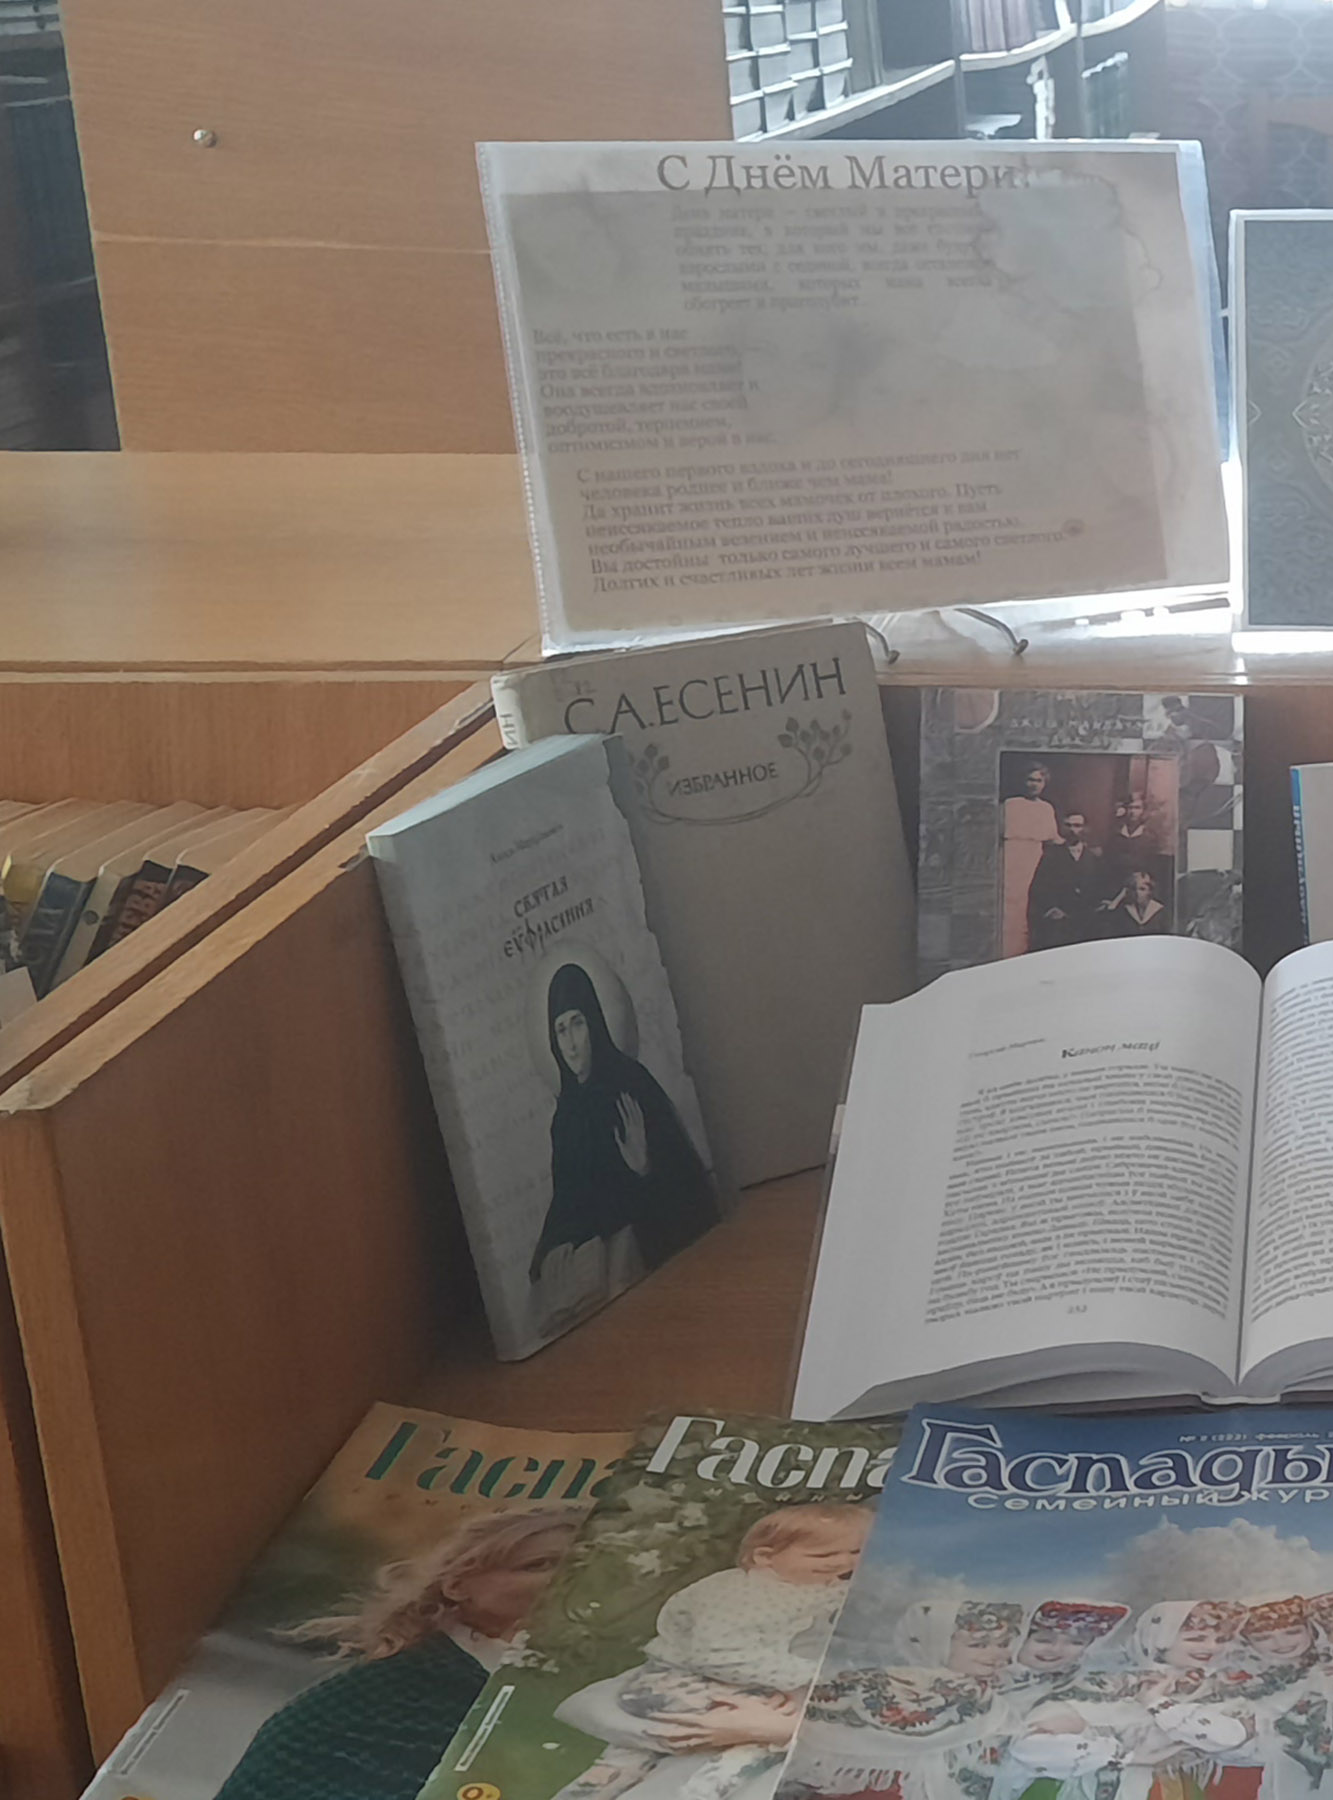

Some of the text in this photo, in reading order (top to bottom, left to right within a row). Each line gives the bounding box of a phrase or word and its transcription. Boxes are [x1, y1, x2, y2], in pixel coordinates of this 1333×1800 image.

[657, 154, 690, 192] С
[703, 153, 831, 197] Днём
[667, 760, 779, 799] ИЗБРАННОЕ
[967, 1488, 1217, 1512] Семейный
